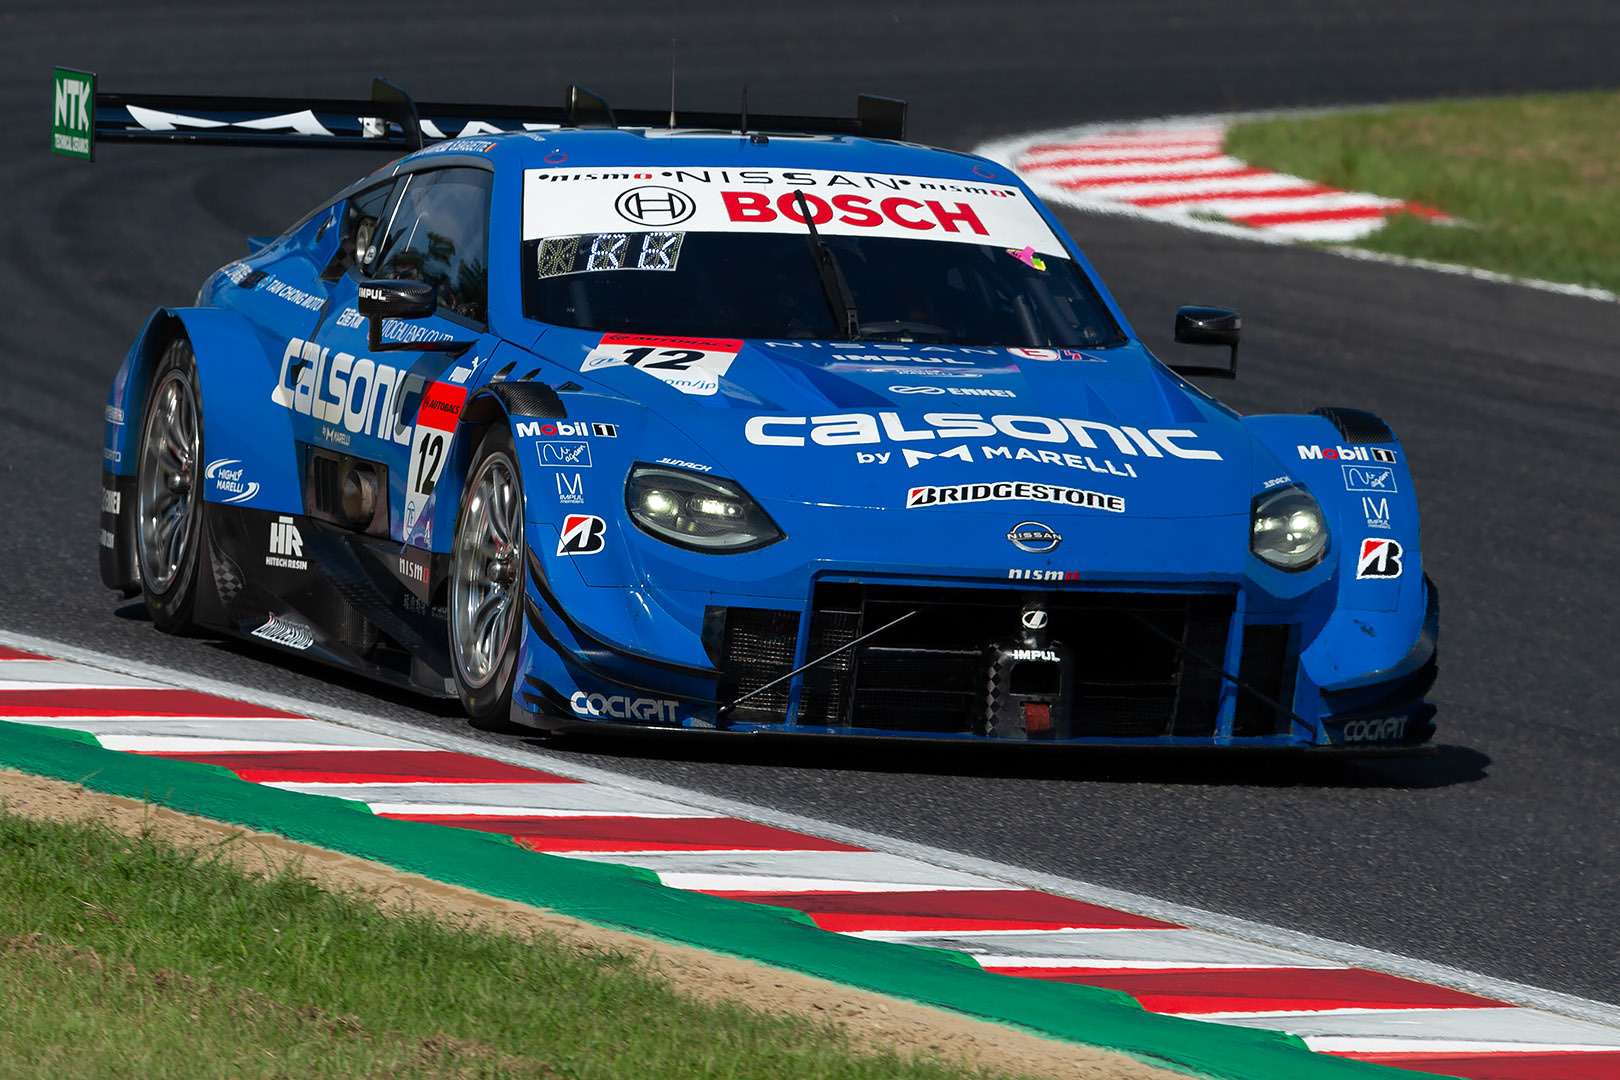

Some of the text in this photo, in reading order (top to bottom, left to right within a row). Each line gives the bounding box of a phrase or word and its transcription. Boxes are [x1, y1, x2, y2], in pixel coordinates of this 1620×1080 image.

[55, 78, 90, 132] NTK
[551, 169, 1007, 198] nismo NISSAN nismo
[720, 190, 990, 236] BOSCH
[622, 346, 706, 371] 12
[831, 354, 976, 366] IMPUL
[946, 387, 1017, 398] ENKEI
[428, 399, 461, 415] AUTOBACS
[516, 421, 590, 438] Mobil
[1297, 445, 1370, 461] Mobil
[414, 432, 444, 495] 12
[856, 451, 891, 464] by
[981, 446, 1138, 478] MARELLI
[218, 468, 244, 482] HIGHLY
[216, 479, 244, 493] MARELLI
[909, 483, 1125, 512] BRIDGESTONE
[1006, 531, 1062, 542] NISSAN
[265, 556, 308, 571] HITECH RESIN
[1008, 568, 1079, 581] nismo
[1013, 649, 1061, 663] IMPUL
[570, 691, 680, 722] COCKPIT
[1343, 715, 1409, 743] COCKPIT
